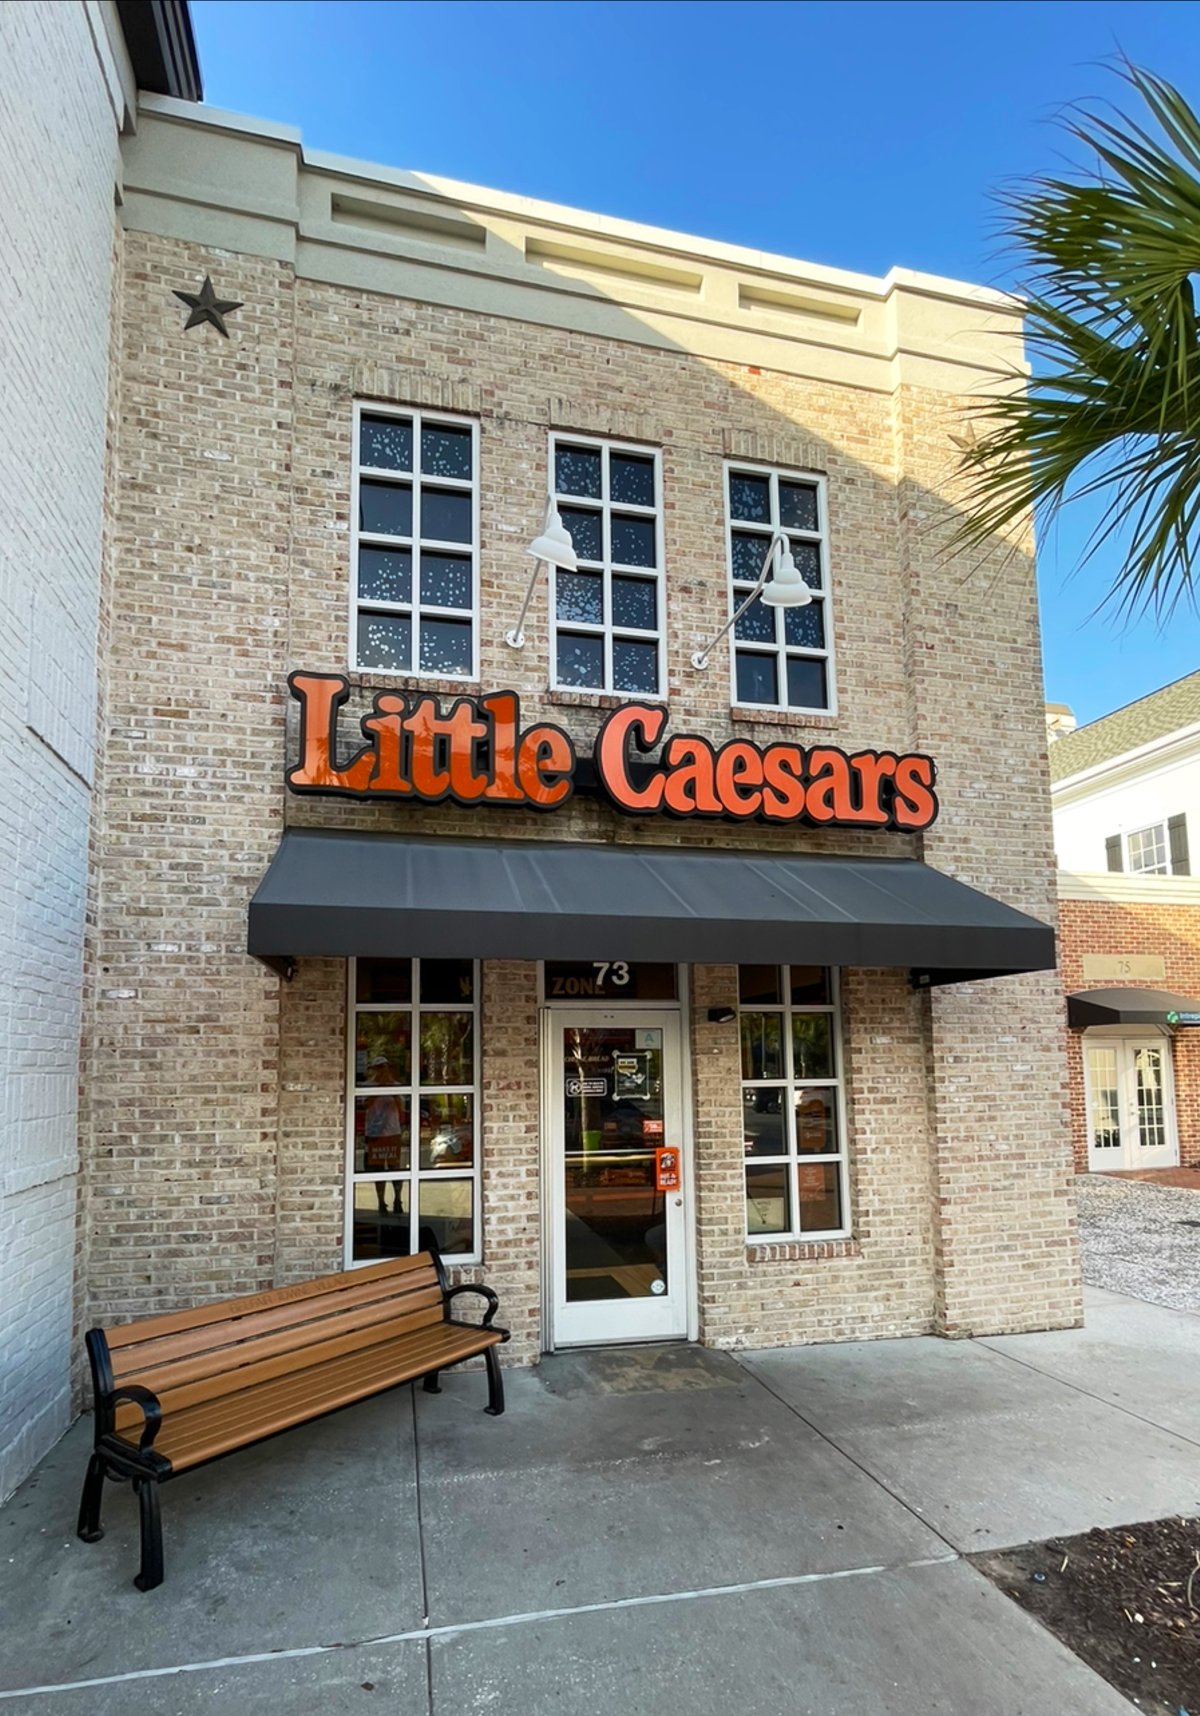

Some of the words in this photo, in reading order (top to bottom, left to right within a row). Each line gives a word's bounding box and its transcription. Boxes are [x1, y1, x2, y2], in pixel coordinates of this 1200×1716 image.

[288, 674, 574, 806] Little
[595, 704, 936, 828] Caesars
[593, 961, 630, 985] 73
